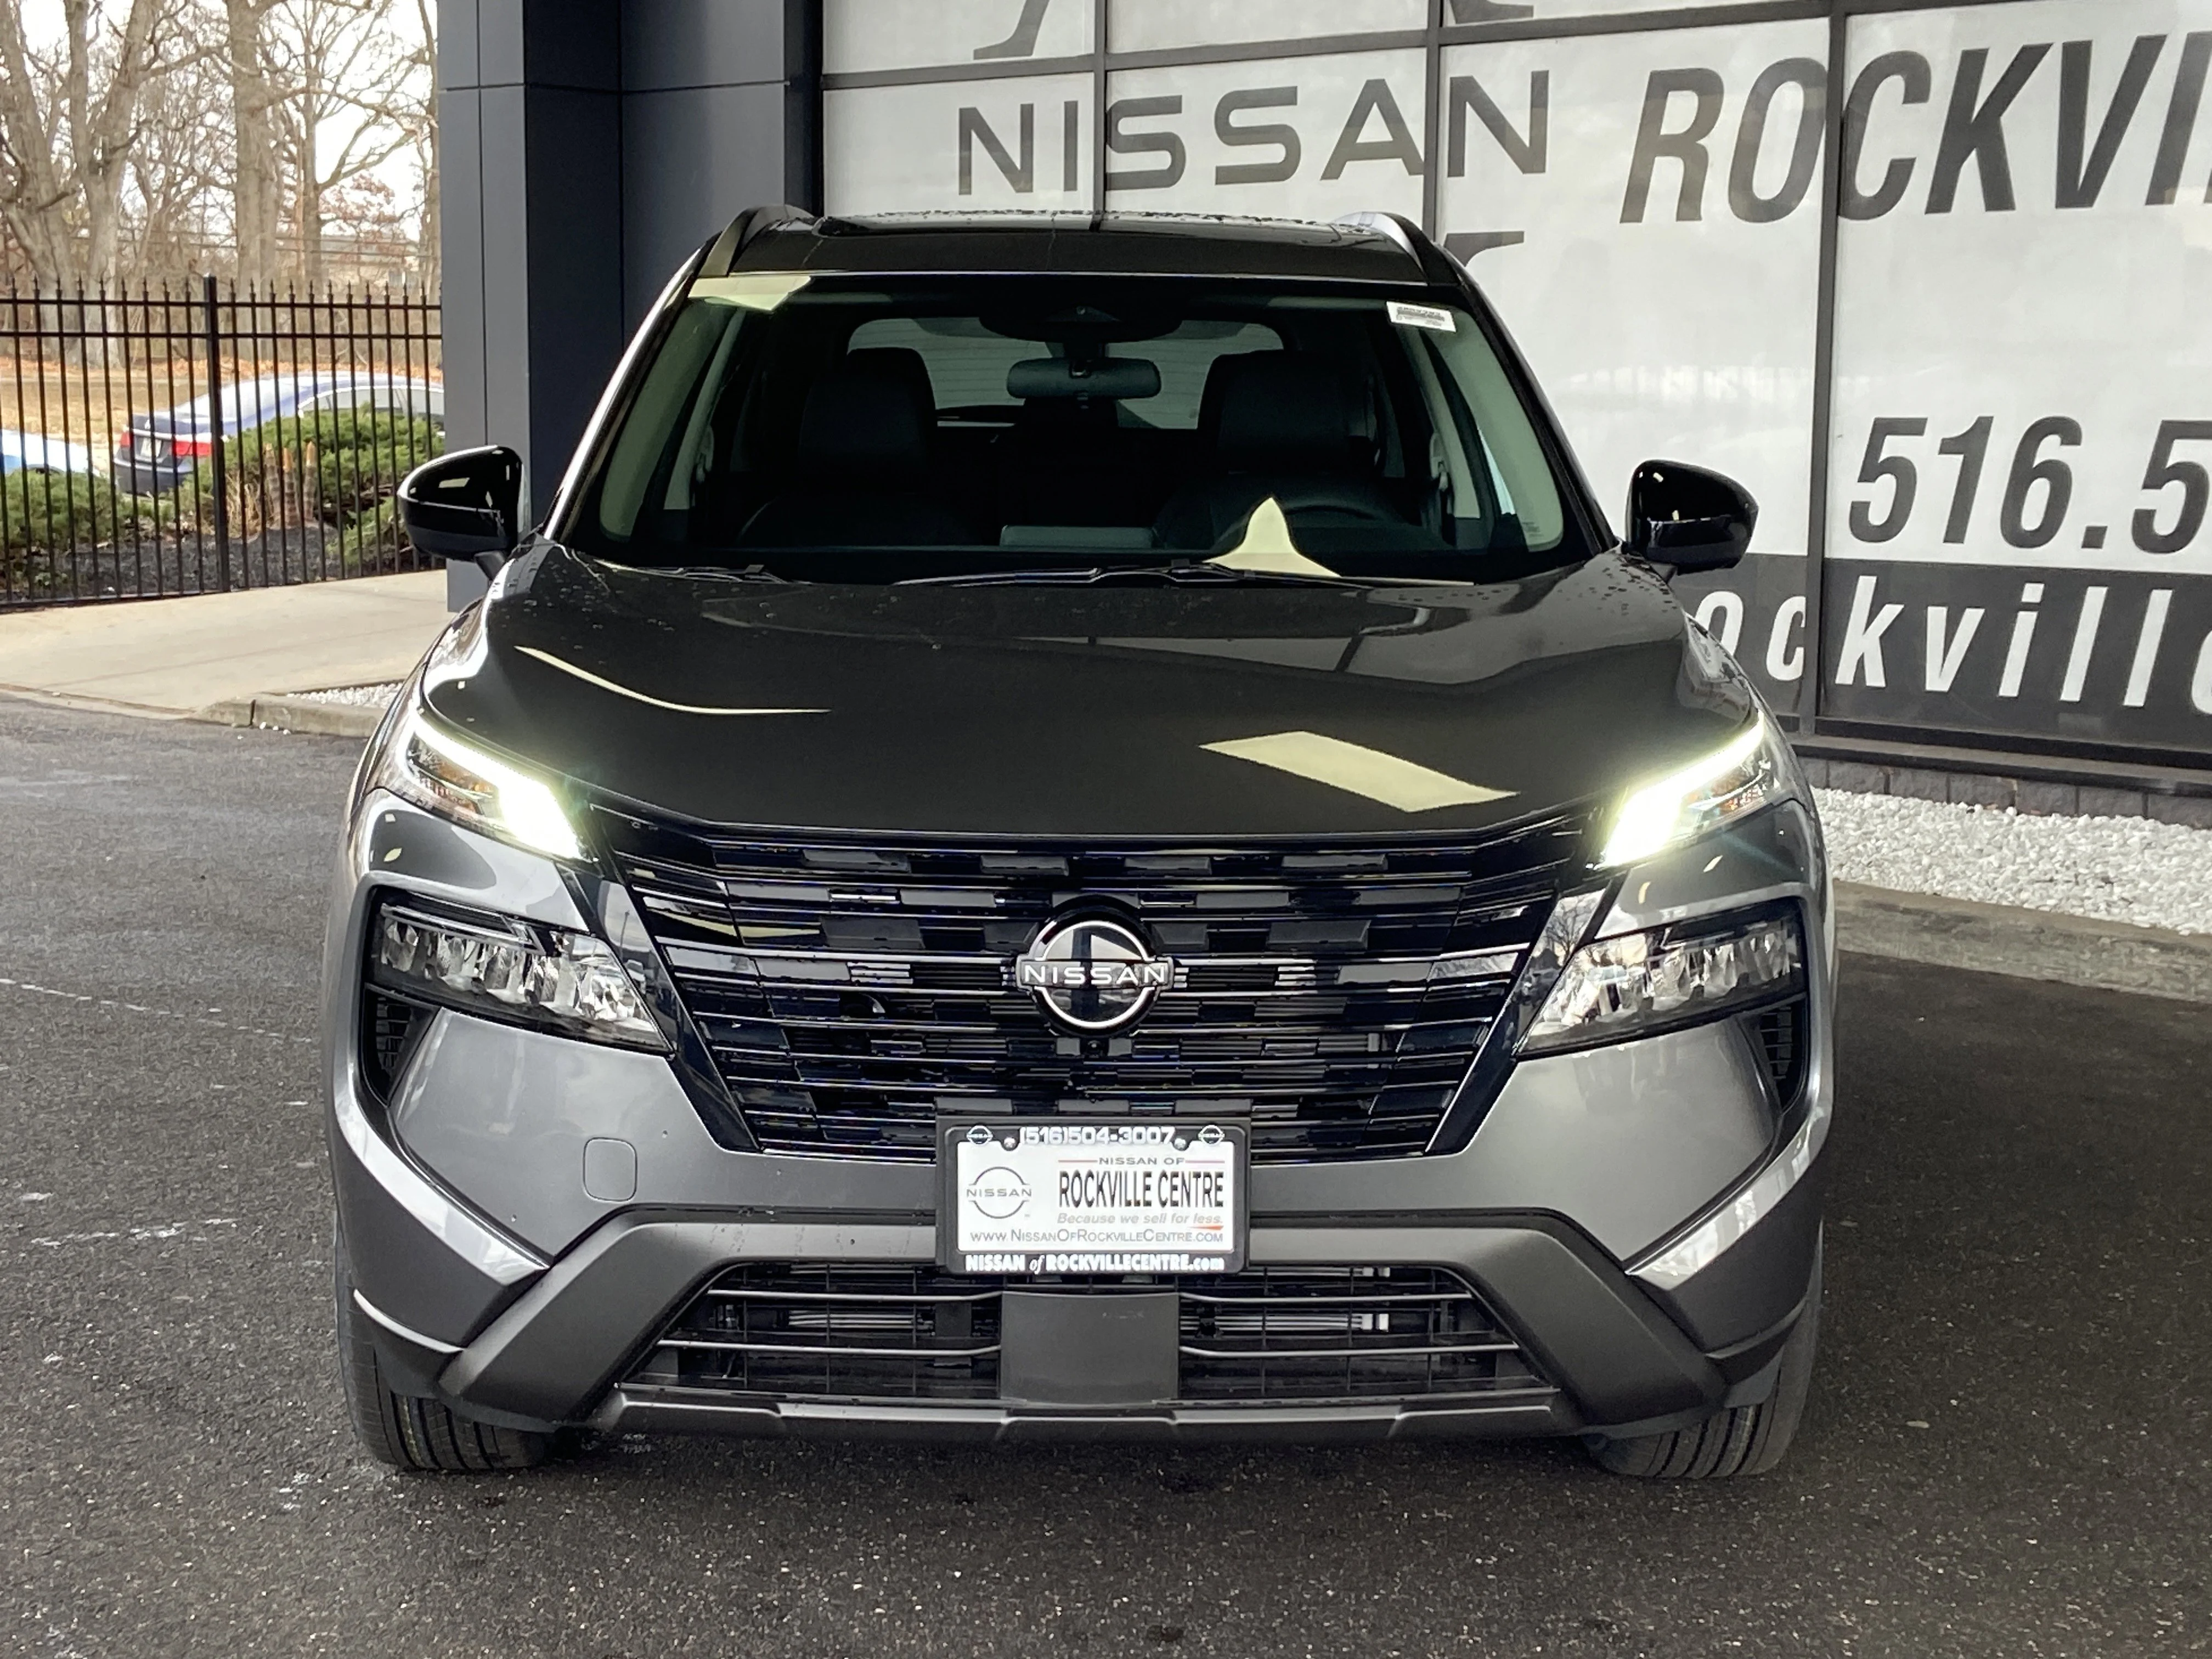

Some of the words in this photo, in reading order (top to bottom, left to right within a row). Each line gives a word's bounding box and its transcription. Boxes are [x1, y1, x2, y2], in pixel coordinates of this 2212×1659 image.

[958, 70, 1549, 195] NISSAN
[1620, 31, 2212, 222] ROCKVI
[1849, 415, 2212, 554] 516.5
[1025, 965, 1165, 984] NISSAN
[966, 1188, 1032, 1197] NISSAN
[1059, 1170, 1152, 1207] ROCKVILLE
[1158, 1170, 1224, 1207] CENTRE
[1057, 1212, 1115, 1224] Because
[1120, 1215, 1139, 1224] we
[1143, 1212, 1167, 1224] sell
[1171, 1212, 1189, 1224] for
[1193, 1213, 1223, 1224] less.
[966, 1254, 1025, 1272] NISSAN
[1029, 1255, 1045, 1275] of
[1046, 1253, 1224, 1272] ROCKVILLECENTRE.com
